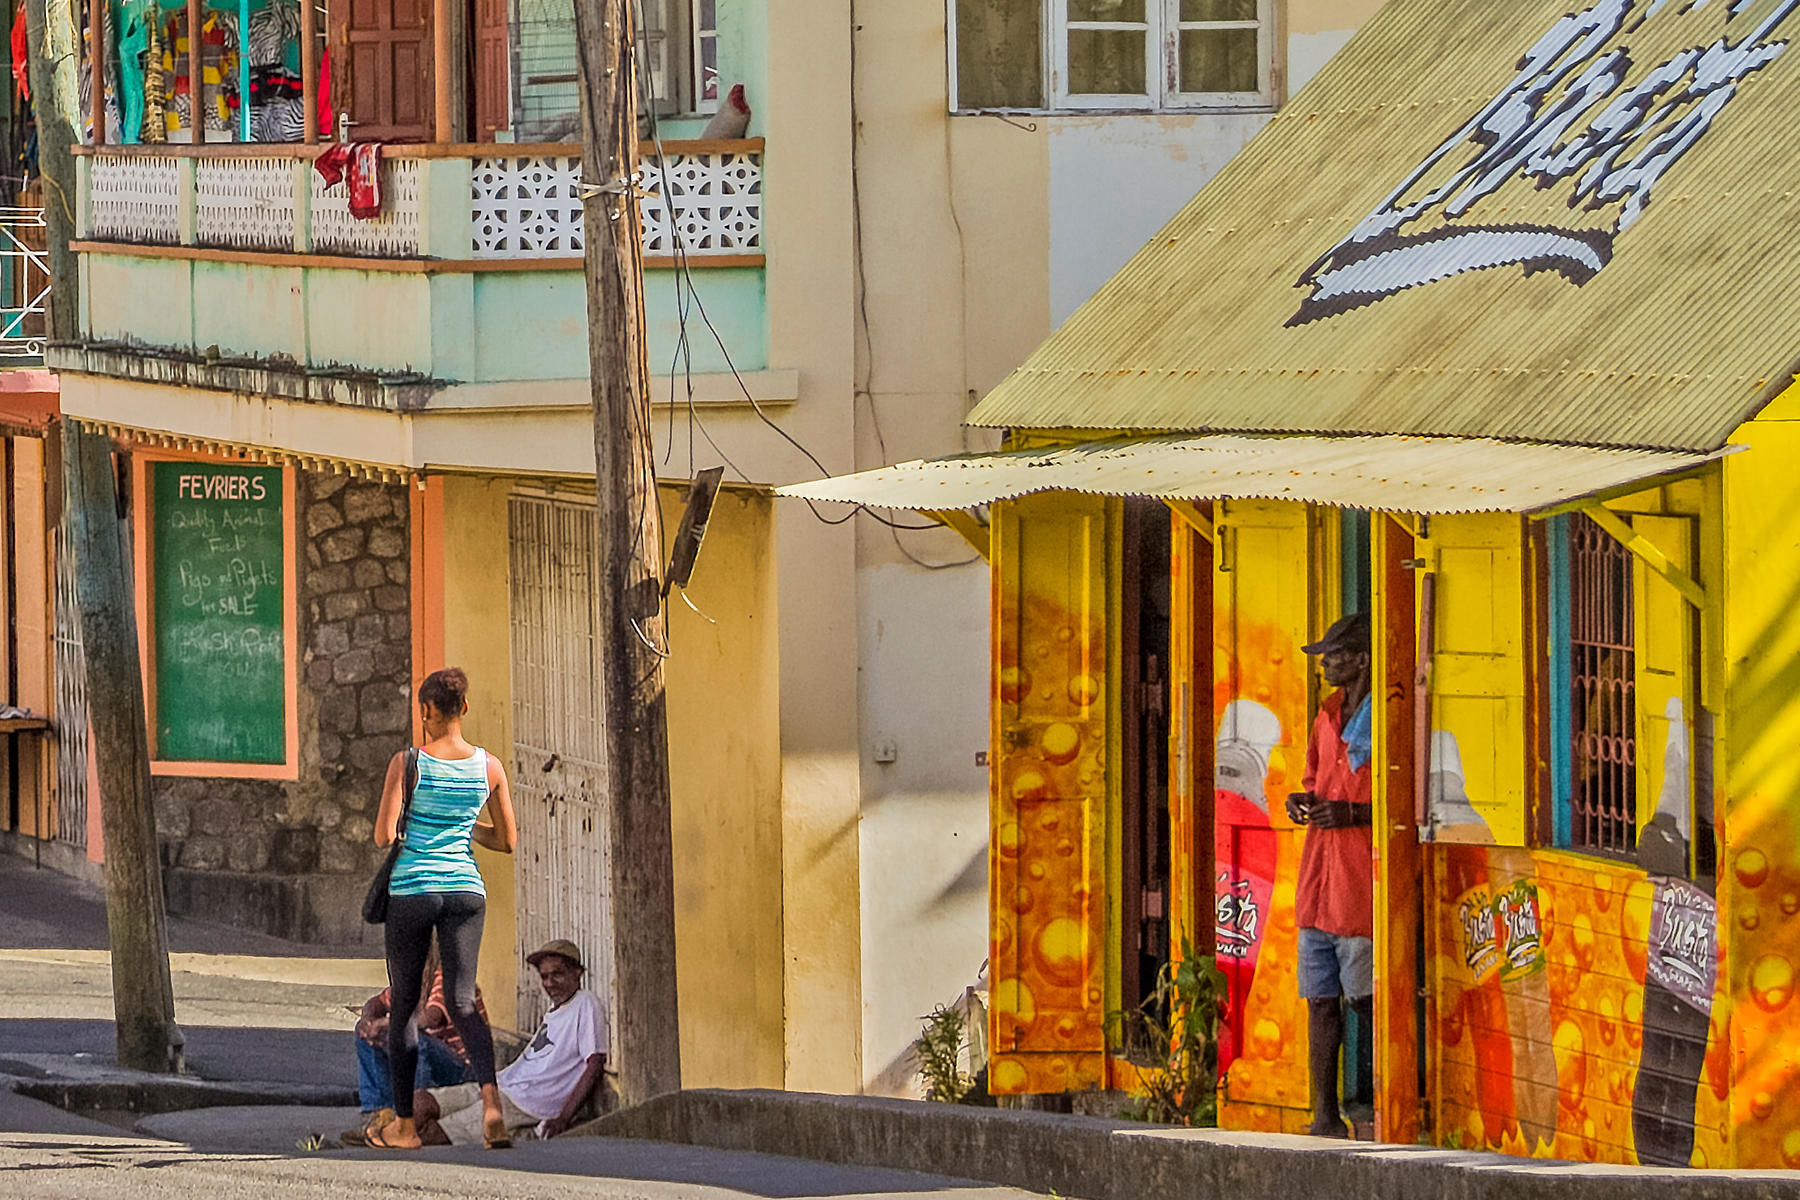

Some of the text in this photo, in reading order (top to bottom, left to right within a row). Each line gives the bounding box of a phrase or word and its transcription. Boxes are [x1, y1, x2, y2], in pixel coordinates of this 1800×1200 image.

[179, 475, 266, 500] FEVRIERS
[219, 595, 259, 616] SALE
[1659, 888, 1709, 979] Busta
